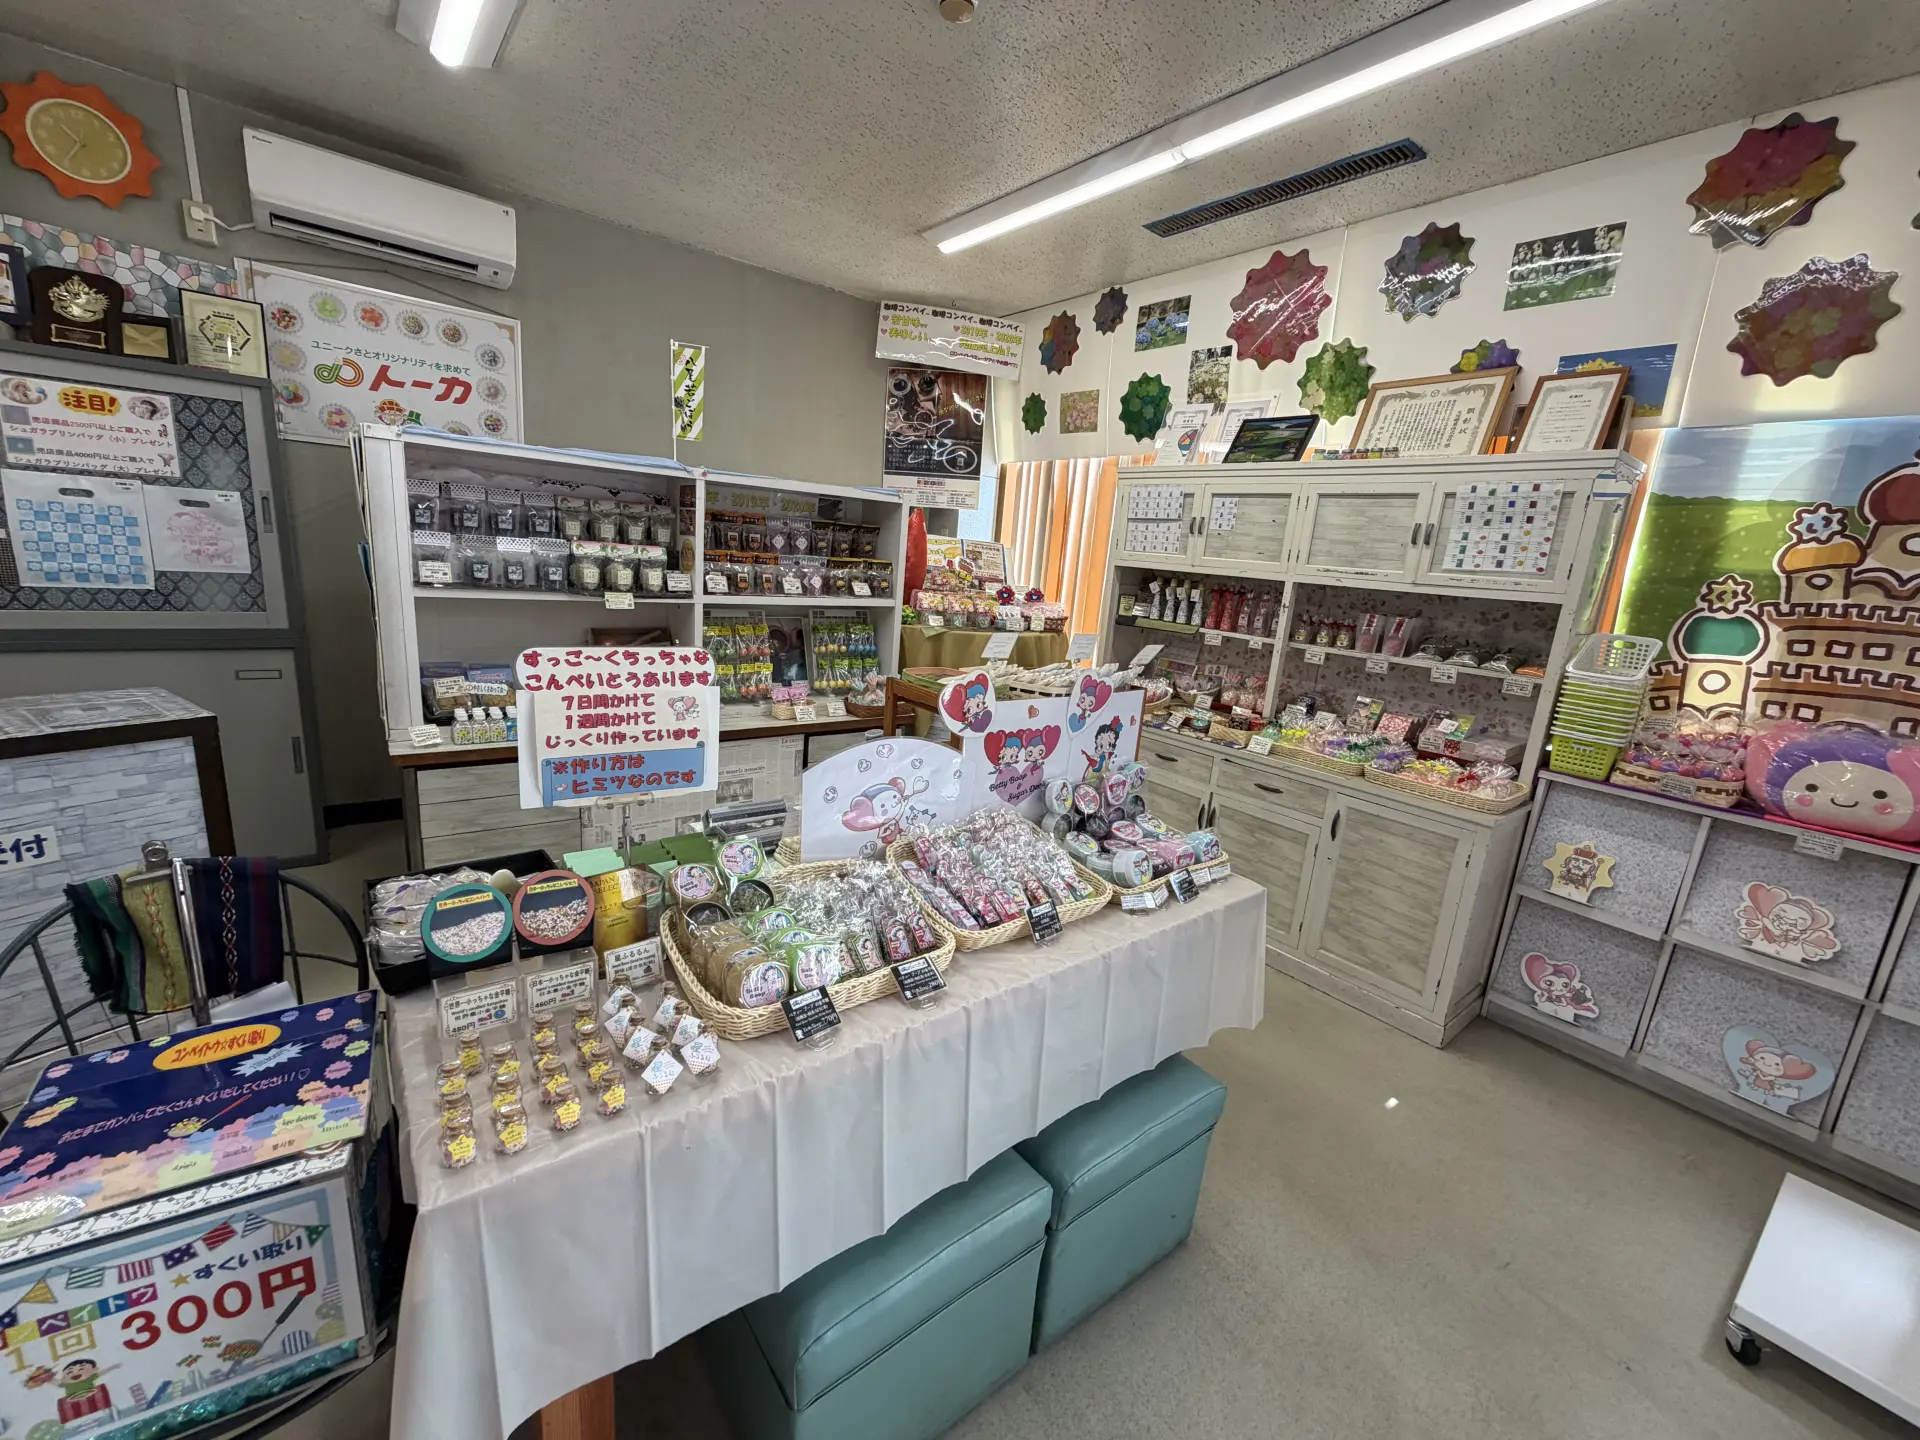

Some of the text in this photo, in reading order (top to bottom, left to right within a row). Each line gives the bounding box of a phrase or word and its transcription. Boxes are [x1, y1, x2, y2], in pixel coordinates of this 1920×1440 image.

[311, 340, 472, 376] ユニークさとオリジナリティを求めて
[368, 364, 473, 405] トーカ
[32, 416, 151, 436] 売店商品2500円以上ご購入で
[36, 447, 155, 465] 売店商品4000円以上ご購入で
[523, 650, 710, 667] すっご〜くちっちゃな
[524, 671, 712, 691] こんぺいとうあります
[561, 693, 656, 710] 7日間かけて
[565, 711, 656, 729] 1週間かけて
[545, 727, 700, 749] じっくり作っています
[572, 769, 696, 794] ヒミツなのです
[989, 773, 1028, 792] Betty Boop
[1008, 788, 1028, 802] Sugar
[614, 948, 650, 962] 星ふるるん
[533, 968, 590, 986] 日本一小っちゃな金平糖
[449, 988, 510, 1010] 世界一小っちゃな金平糖
[535, 997, 556, 1008] 460円
[452, 1022, 476, 1033] 480円
[193, 1233, 304, 1280] すくい取り
[121, 1257, 317, 1351] 300円
